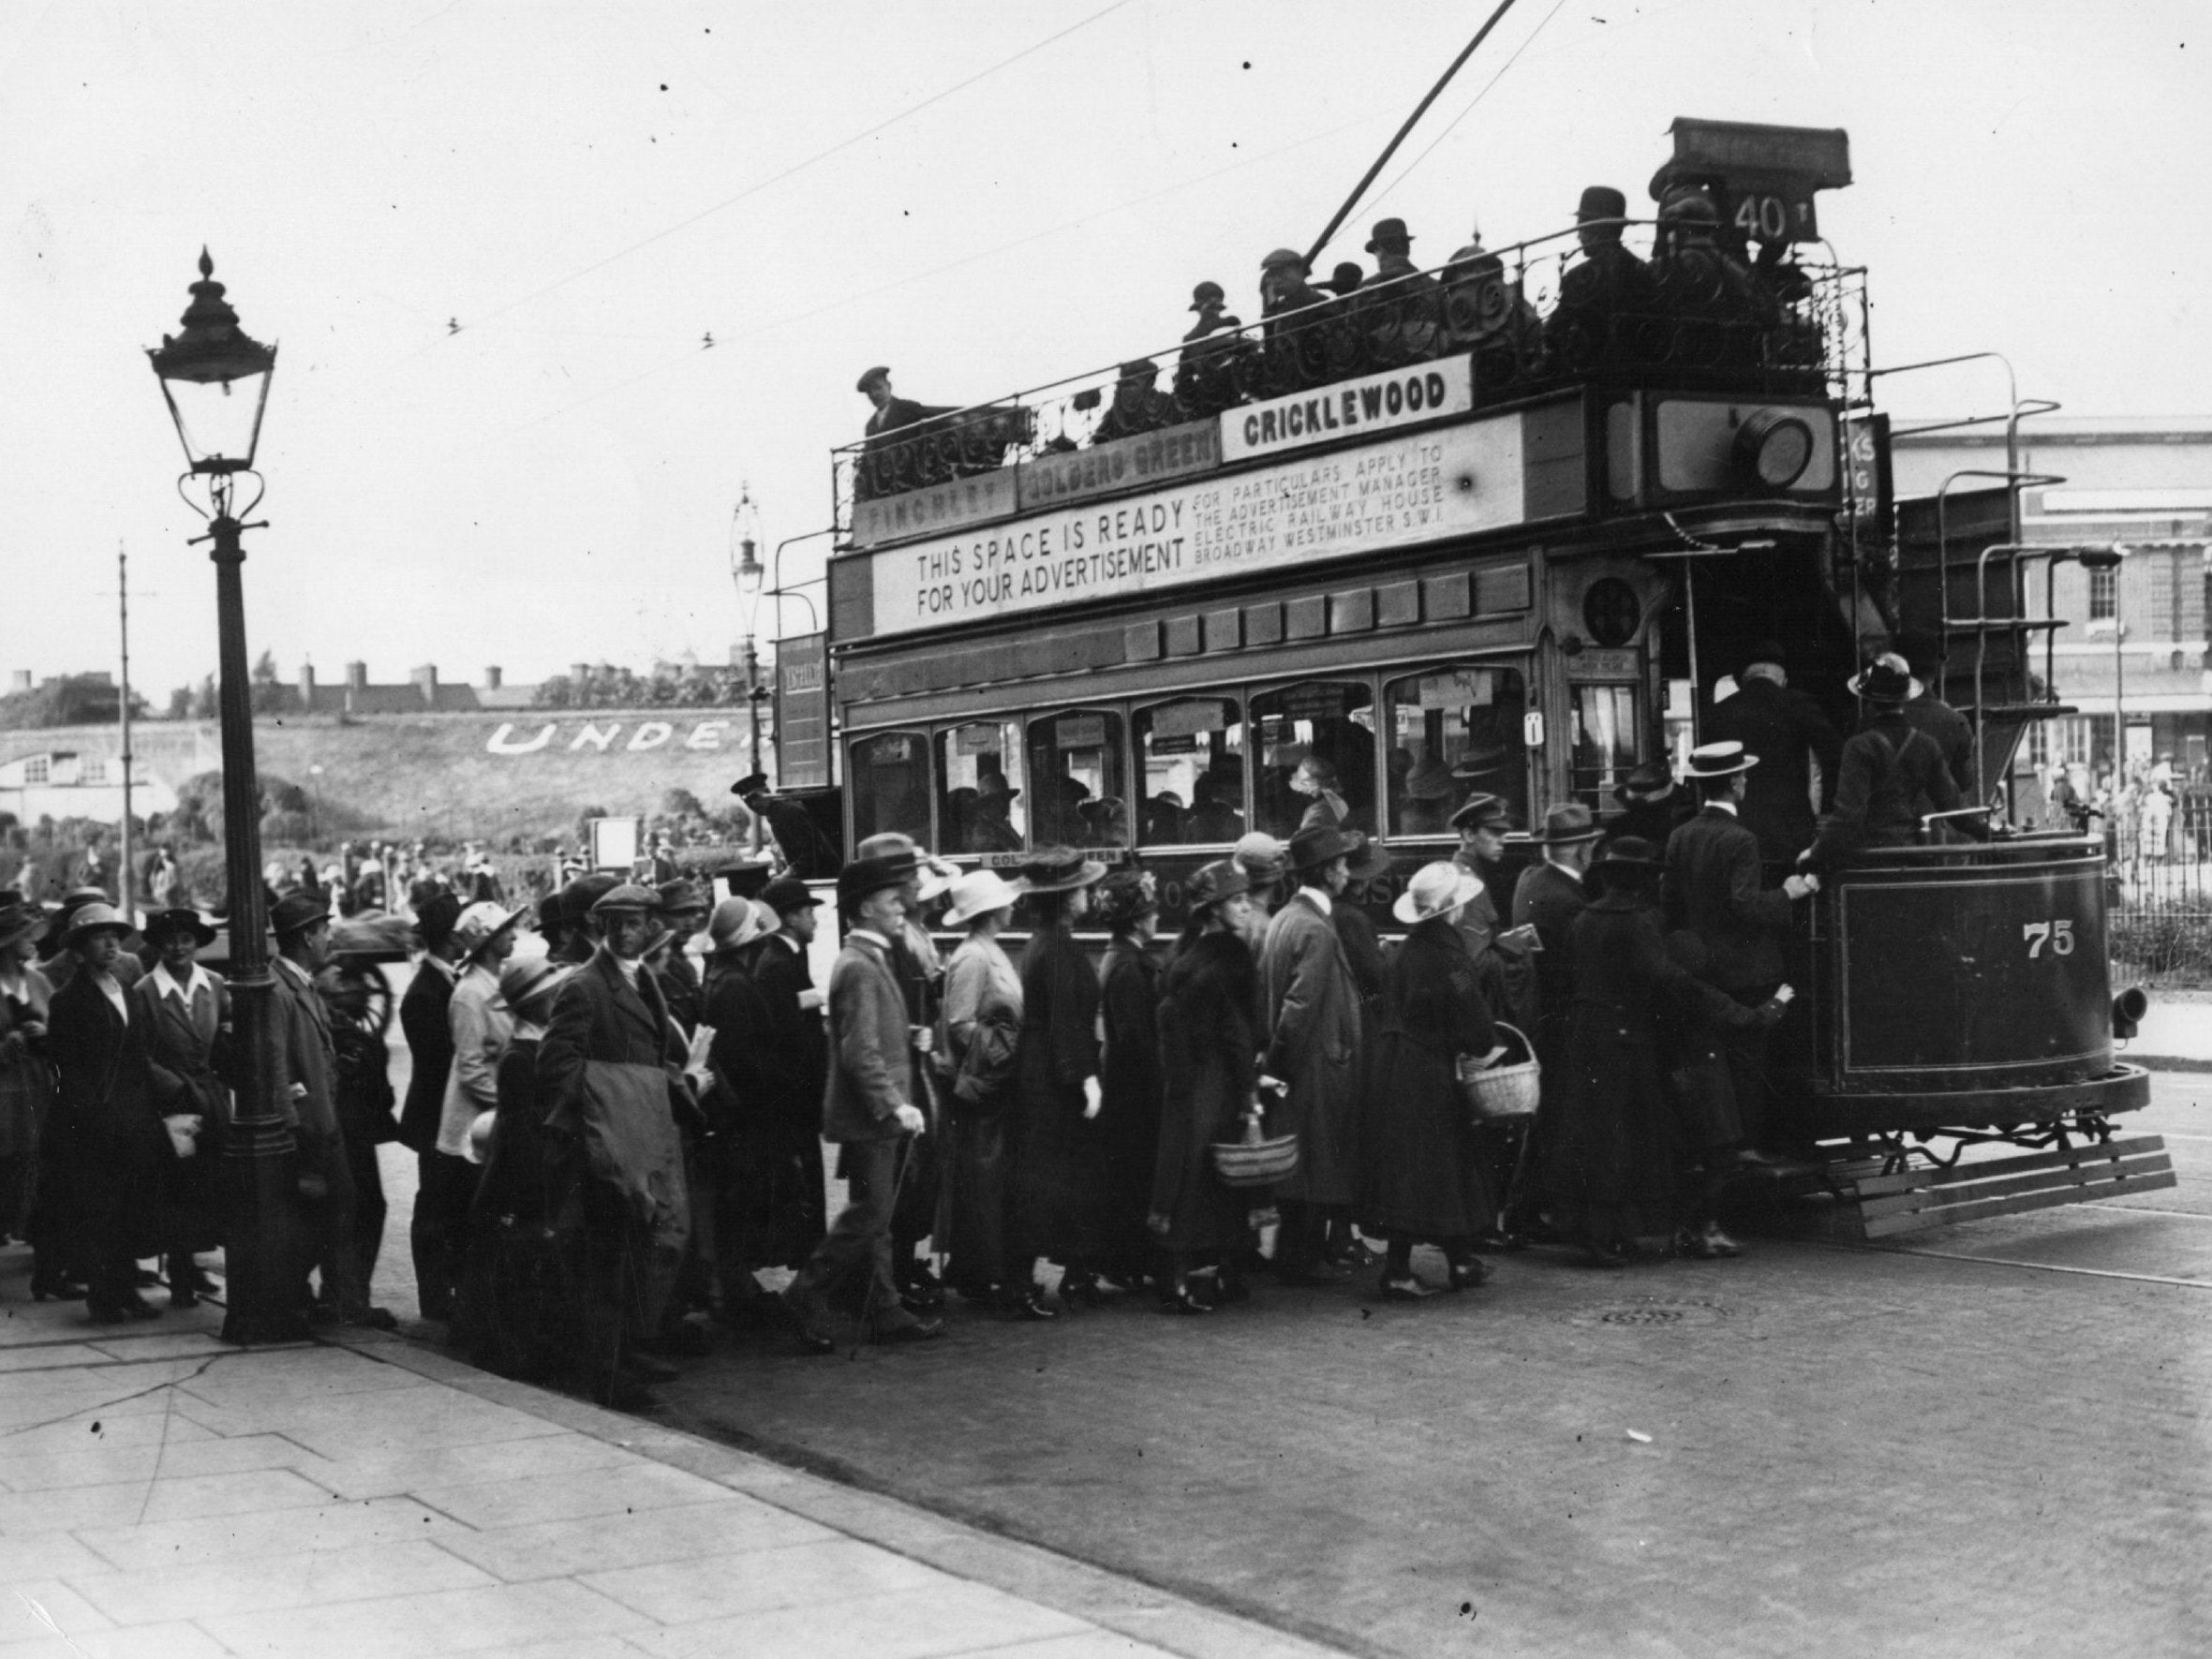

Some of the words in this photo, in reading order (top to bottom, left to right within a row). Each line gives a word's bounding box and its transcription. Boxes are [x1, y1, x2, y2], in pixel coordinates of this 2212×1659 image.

[1734, 194, 1786, 239] 40
[1243, 372, 1445, 447] CRICKLEWOOD
[1194, 491, 1221, 511] FOR
[1233, 465, 1341, 502] PARTICULARS
[1356, 452, 1405, 478] APPLY
[1419, 444, 1443, 463] TO
[1195, 506, 1222, 527] THE
[1230, 482, 1350, 523] ADVERTISEMENT
[1358, 467, 1442, 497] MANAGER
[917, 548, 961, 581] THIS
[972, 527, 1051, 571] SPACE
[1063, 521, 1085, 553] IS
[1098, 498, 1184, 543] READY
[1194, 517, 1274, 548] ELECTRIC
[1287, 502, 1367, 527] RAILWAY
[1381, 485, 1444, 511] HOUSE
[1194, 537, 1276, 564] BROADWAY
[1284, 514, 1395, 549] WESTMINSTER
[917, 585, 954, 615] FOR
[961, 573, 1014, 609] YOUR
[1020, 537, 1185, 597] ADVERTISEMENT
[485, 719, 774, 754] UNDE
[2023, 920, 2075, 958] 75
